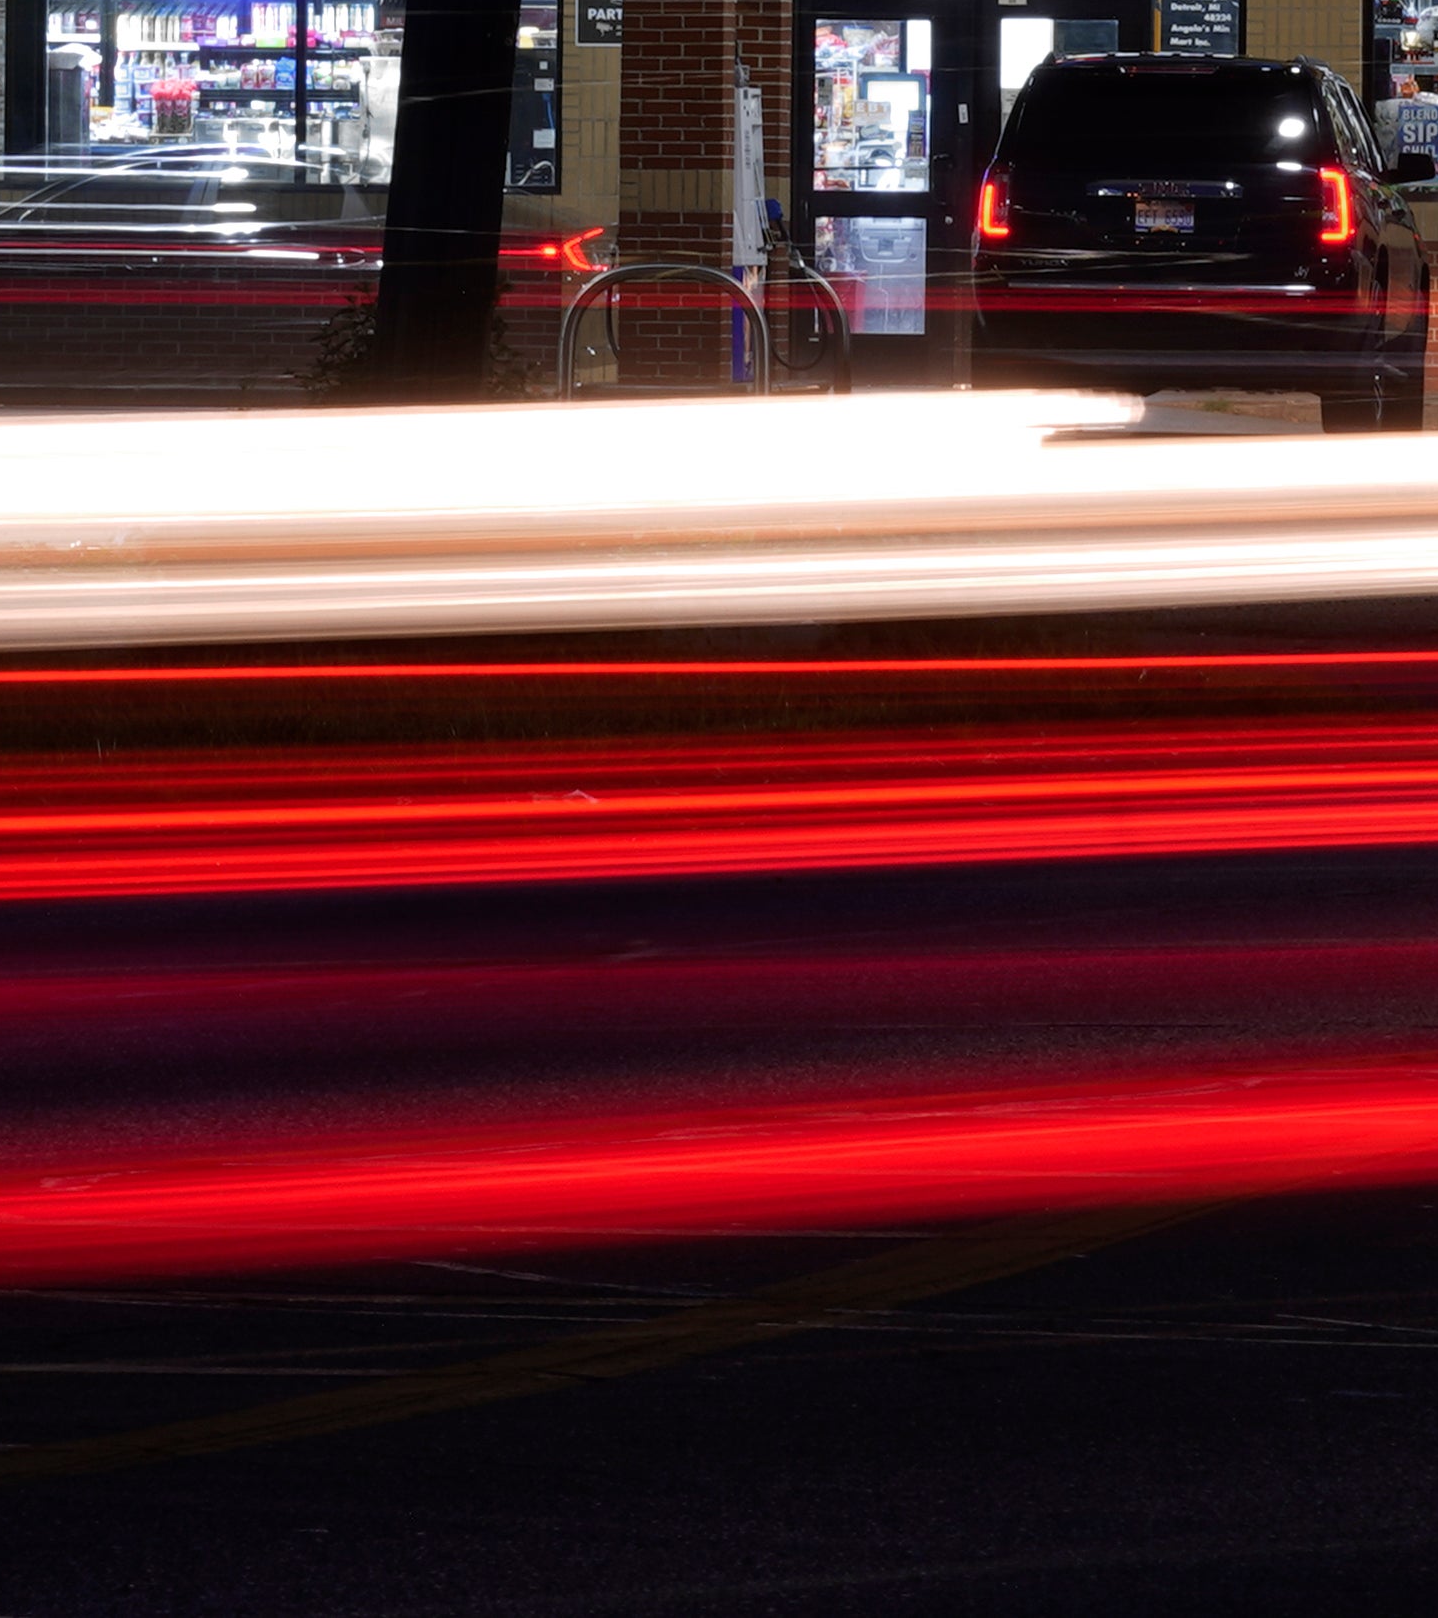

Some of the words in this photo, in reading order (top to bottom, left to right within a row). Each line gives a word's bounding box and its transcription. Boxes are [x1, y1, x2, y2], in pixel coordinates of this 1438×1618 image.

[587, 8, 623, 20] PART
[1402, 109, 1438, 120] BLEND
[1403, 123, 1438, 142] SIP
